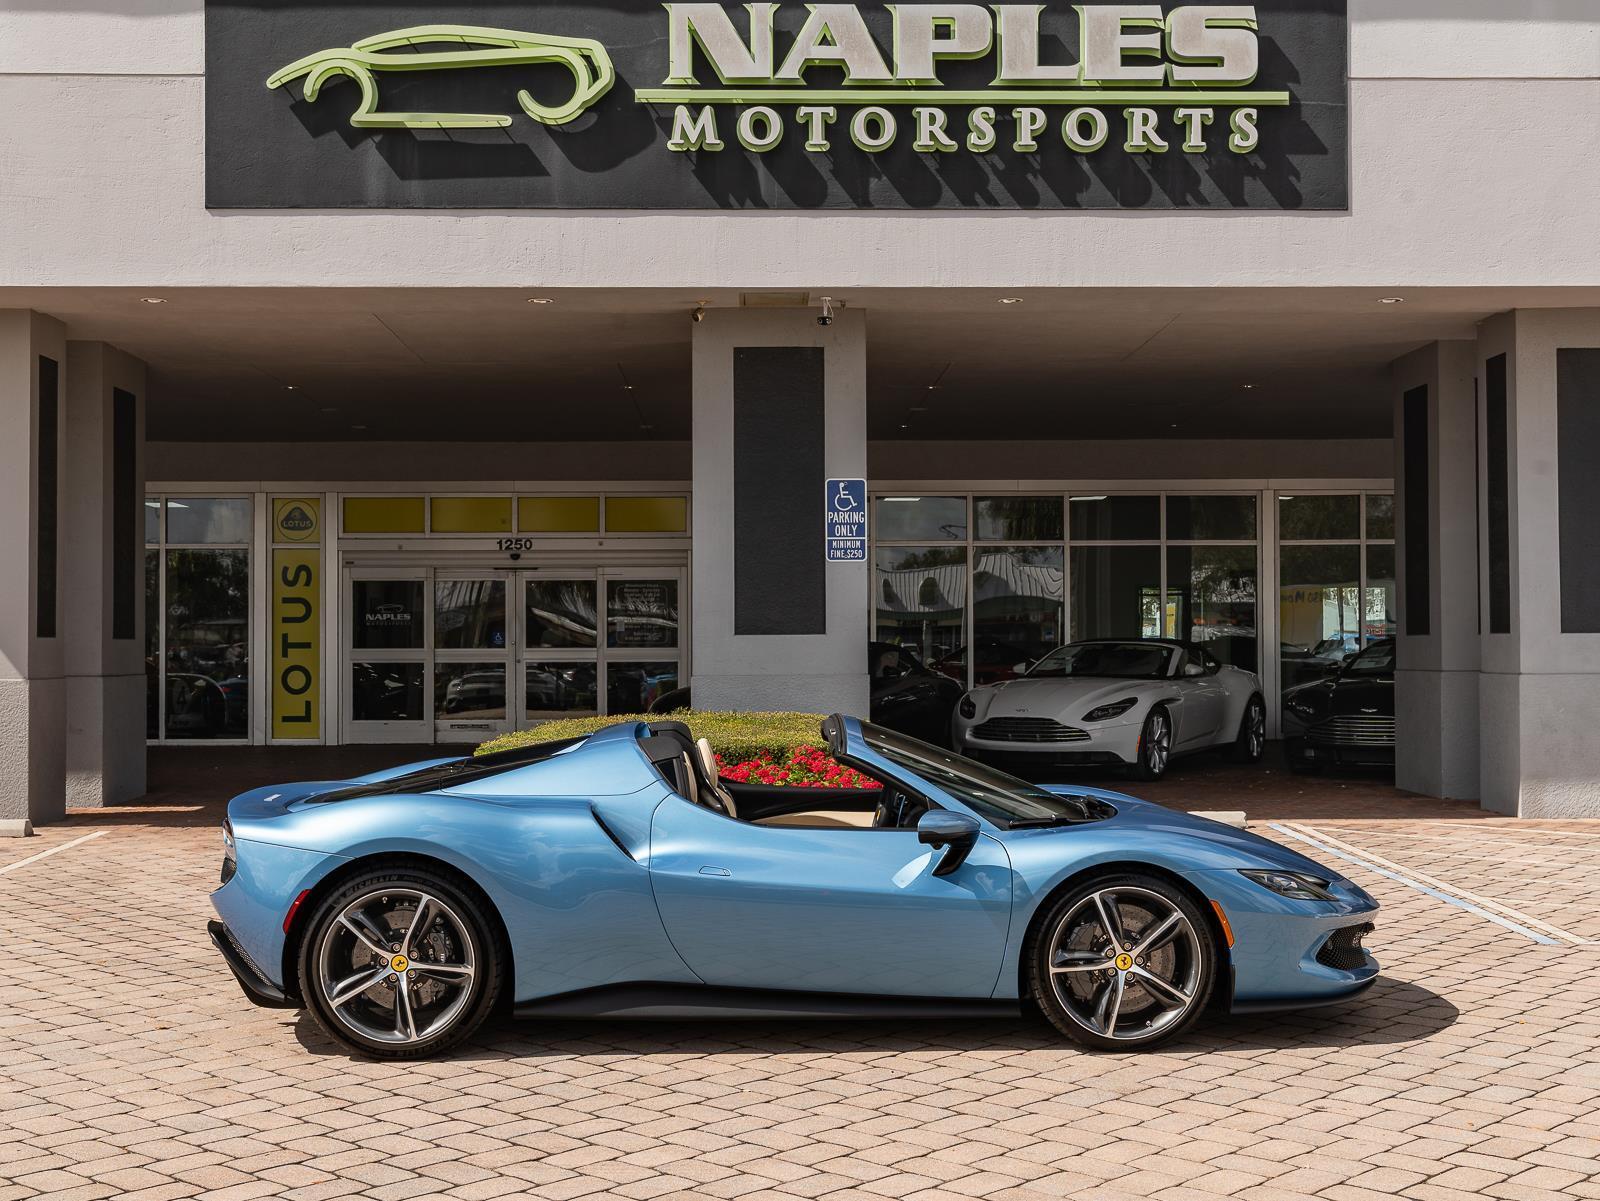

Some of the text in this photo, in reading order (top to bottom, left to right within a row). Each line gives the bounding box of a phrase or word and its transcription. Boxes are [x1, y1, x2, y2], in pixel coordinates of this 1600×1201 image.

[661, 3, 1260, 87] NAPLES
[666, 105, 1260, 153] MOTORSPORTS
[828, 511, 864, 523] PARKING
[283, 520, 312, 528] LOTUS
[835, 525, 857, 536] ONLY
[497, 539, 533, 550] 1250
[832, 540, 860, 548] MINIMUM
[830, 549, 863, 558] FINE $250
[281, 564, 312, 722] LOTUS
